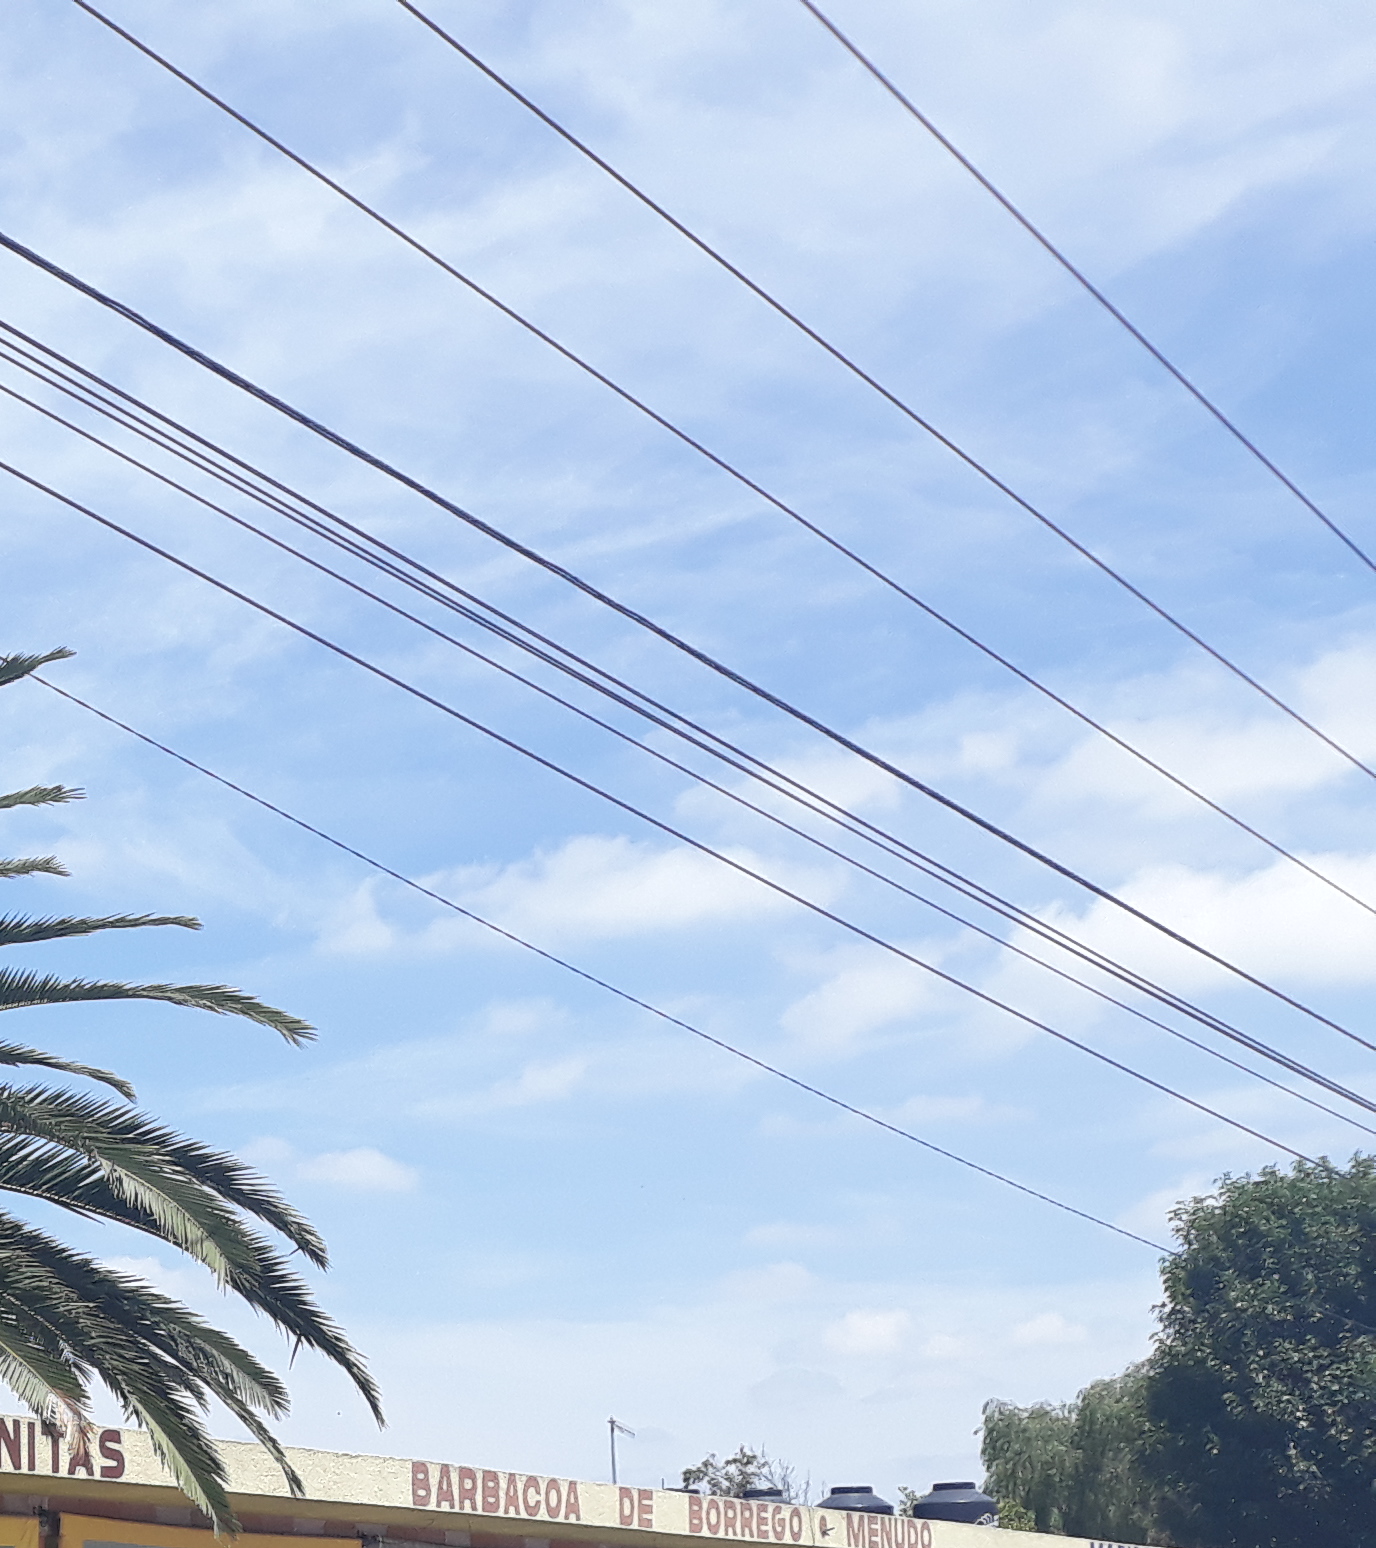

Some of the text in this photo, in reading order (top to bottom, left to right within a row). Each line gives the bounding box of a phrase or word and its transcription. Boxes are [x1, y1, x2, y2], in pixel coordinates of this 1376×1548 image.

[411, 1461, 581, 1521] BARBACOA
[618, 1486, 654, 1529] DE
[688, 1495, 802, 1542] BORREGO
